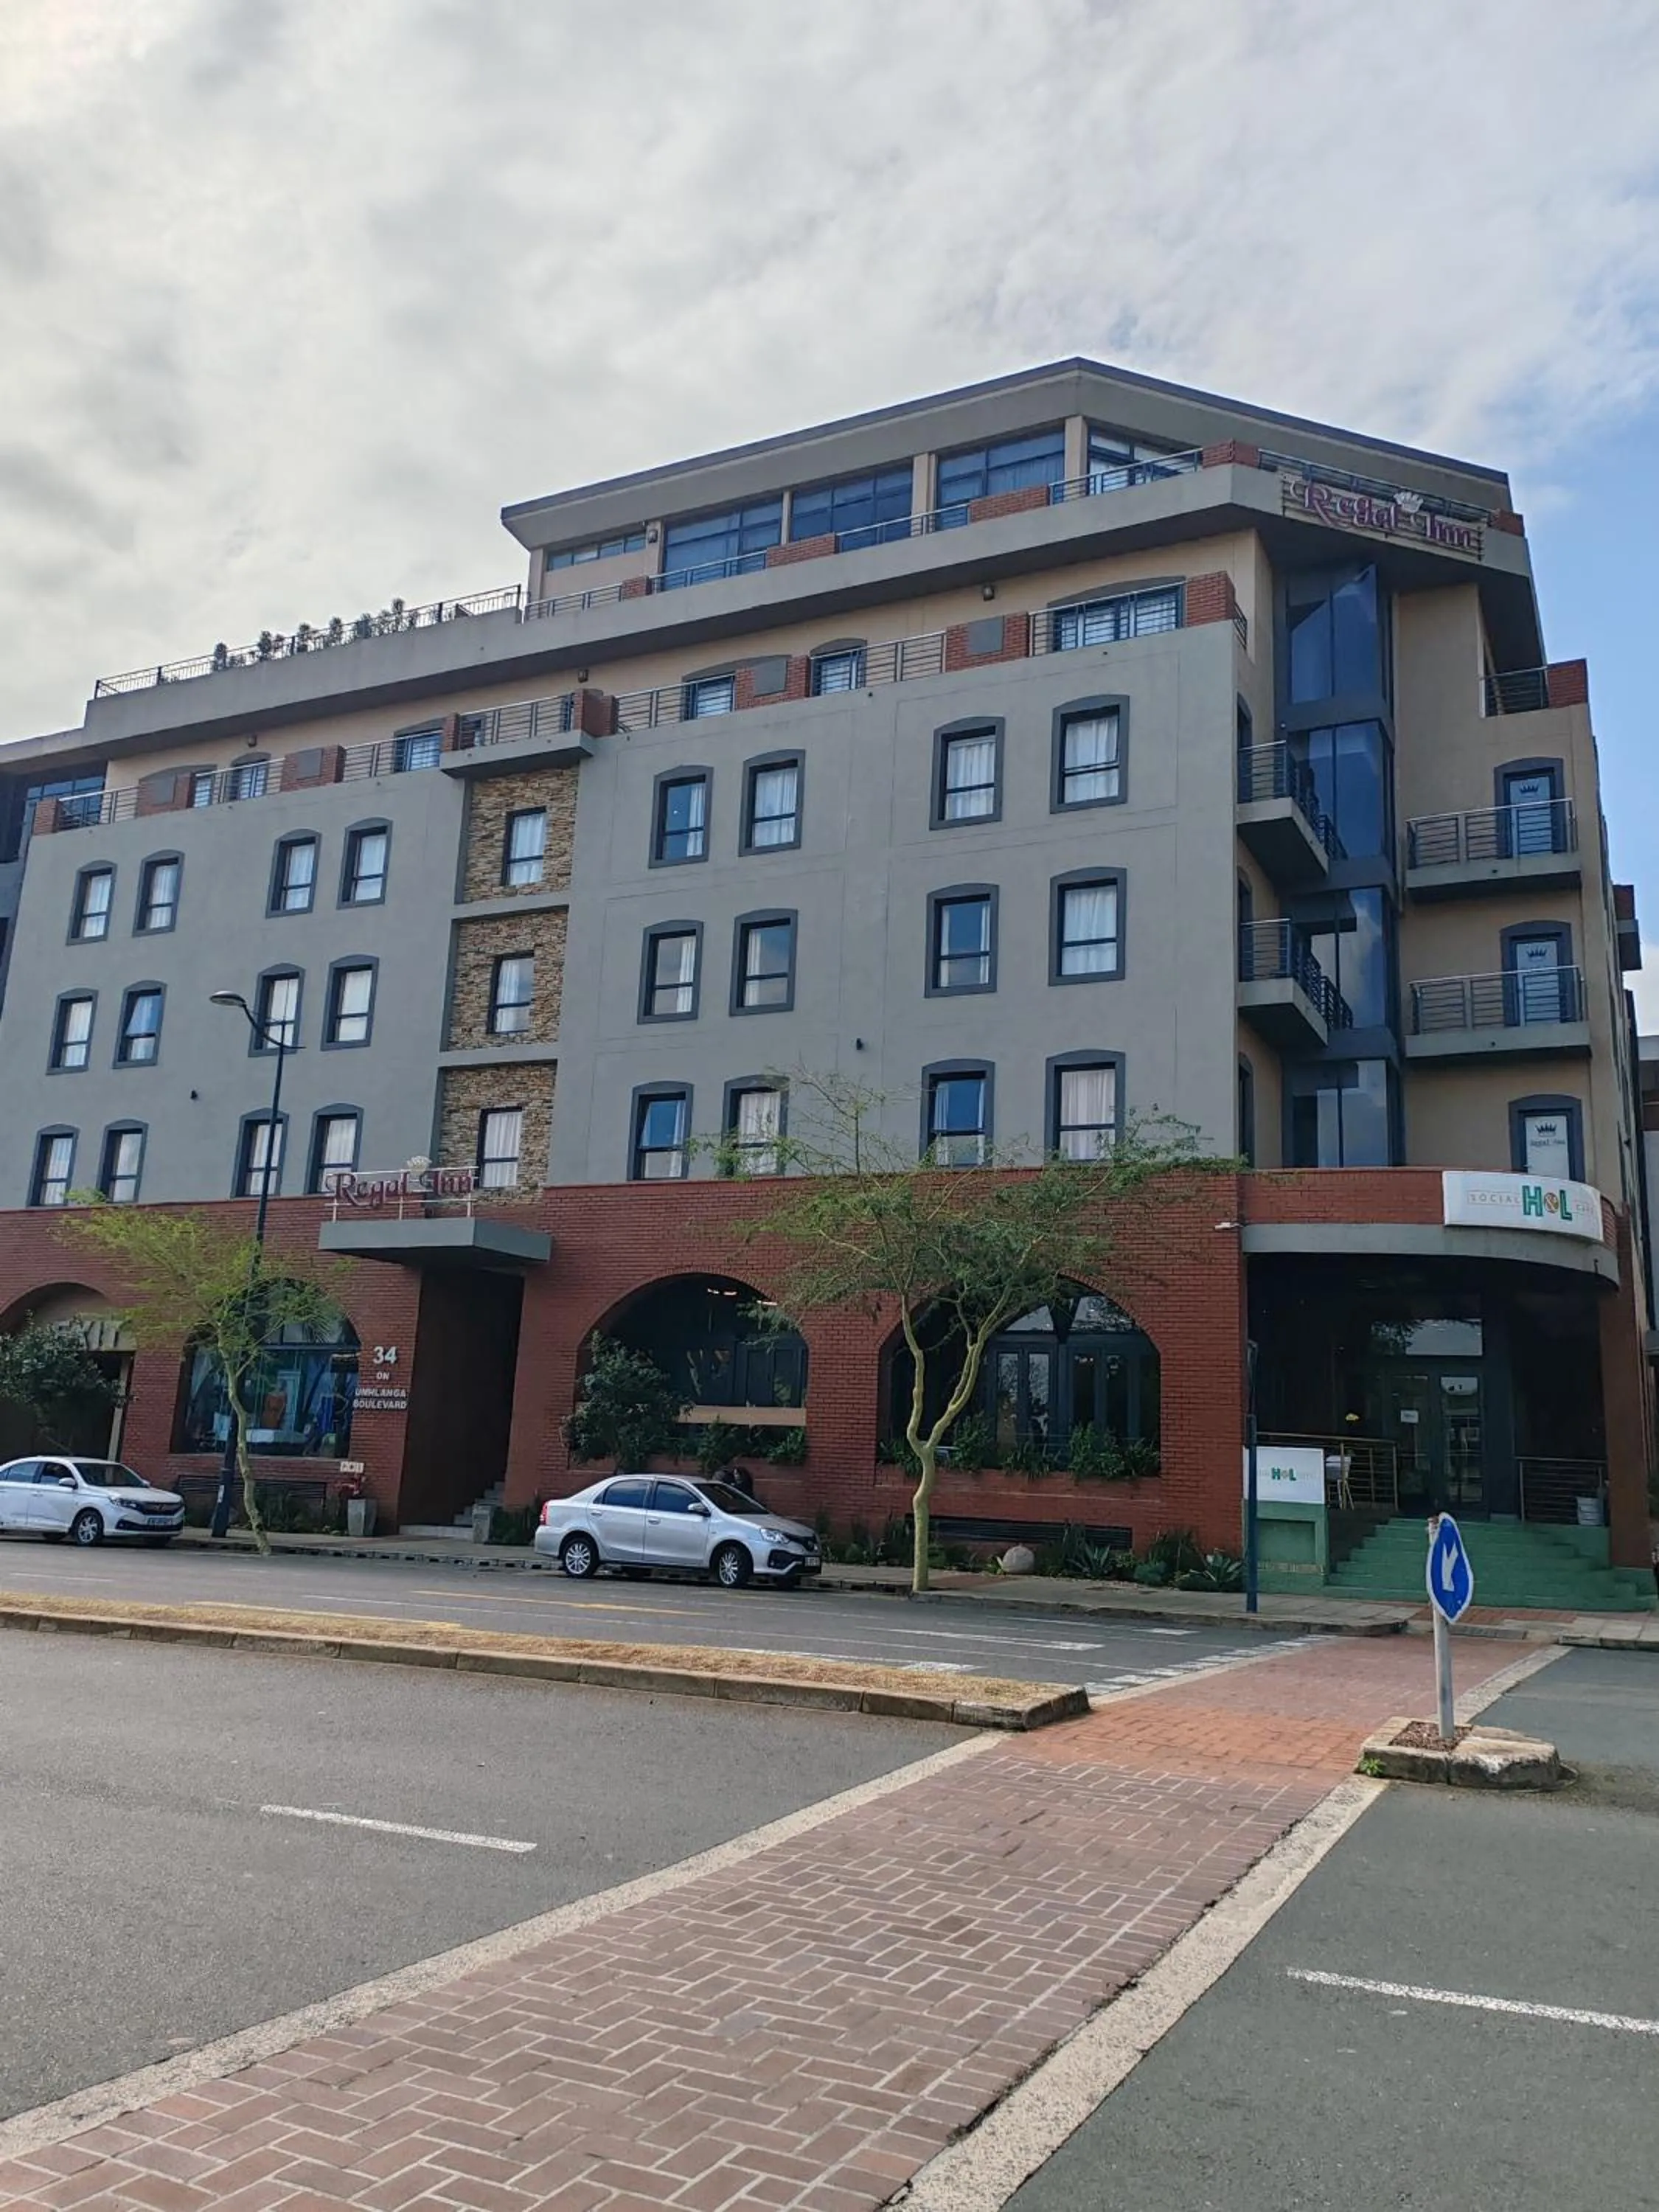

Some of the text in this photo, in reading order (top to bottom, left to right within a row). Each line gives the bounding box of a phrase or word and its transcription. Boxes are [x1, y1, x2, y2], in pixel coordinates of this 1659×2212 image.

[1290, 480, 1472, 548] Regal Inn
[325, 1171, 473, 1208] Regal Inn
[373, 1346, 398, 1364] 34
[376, 1371, 390, 1380] ON
[352, 1399, 408, 1410] BOULEVARD
